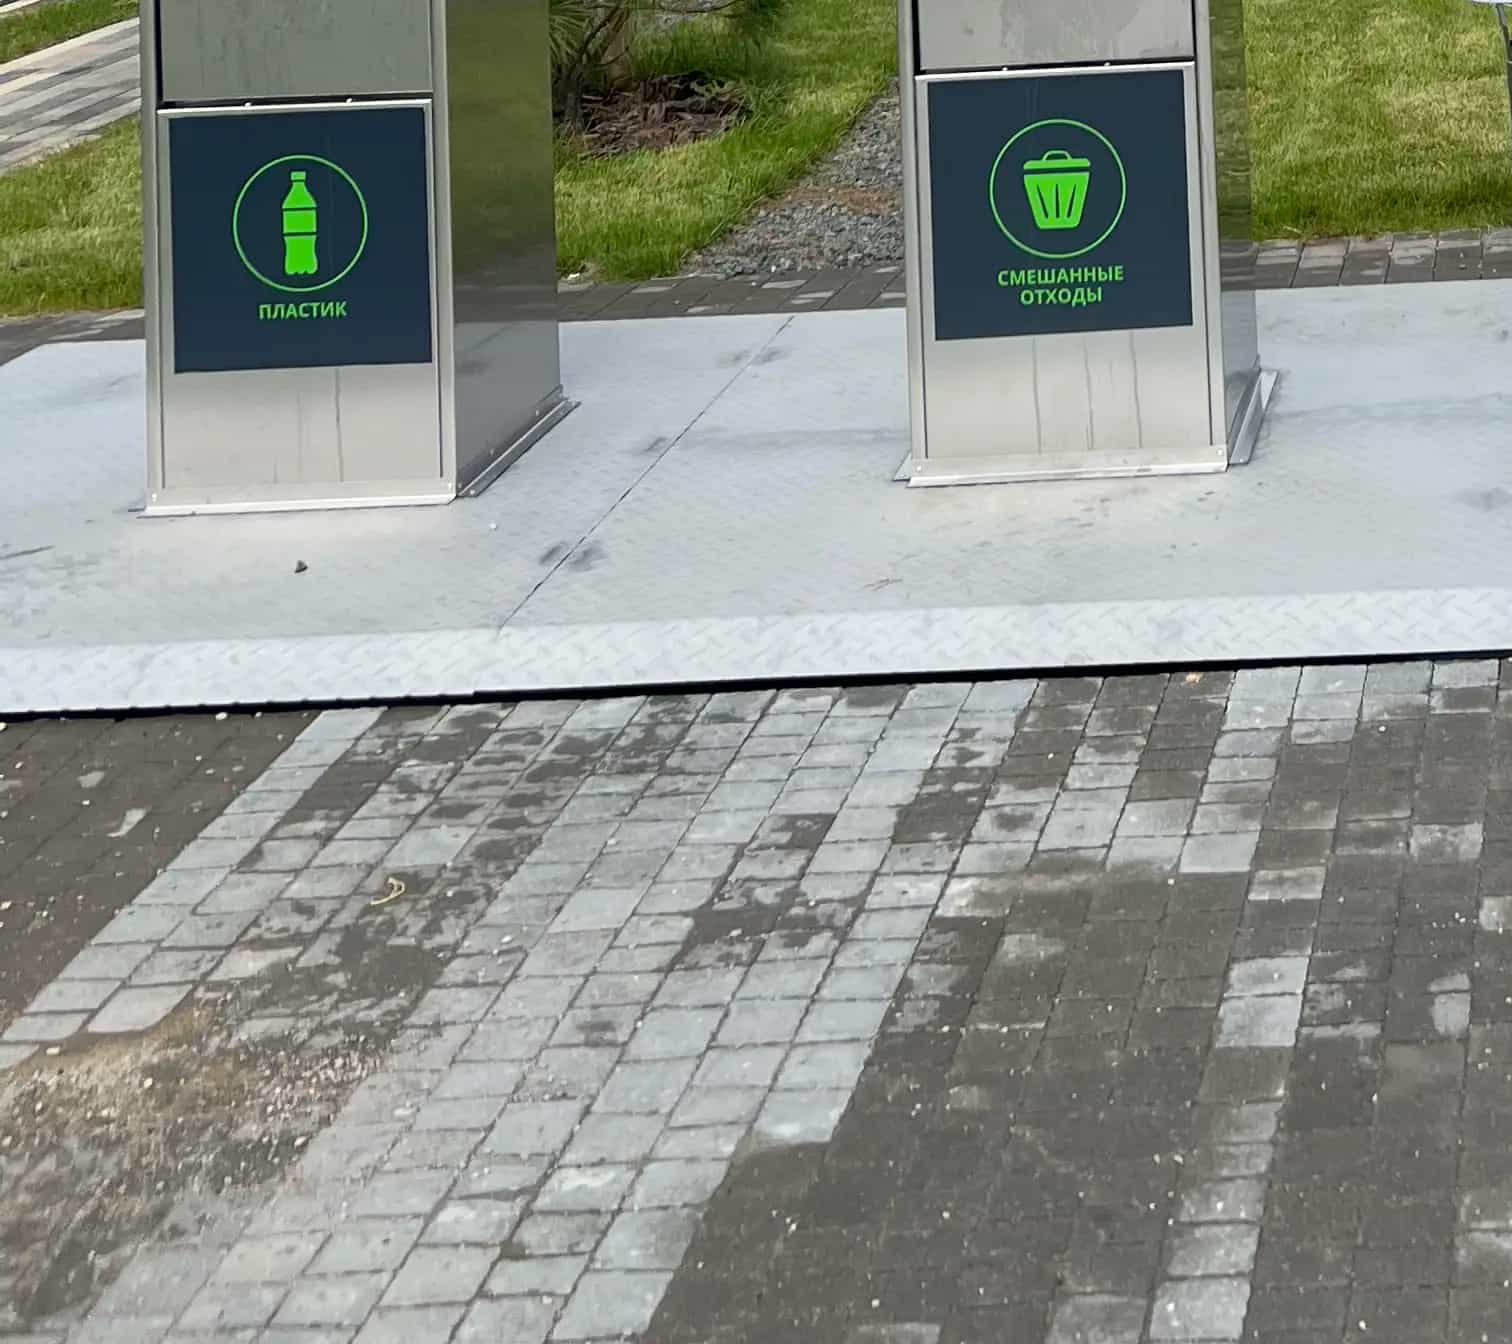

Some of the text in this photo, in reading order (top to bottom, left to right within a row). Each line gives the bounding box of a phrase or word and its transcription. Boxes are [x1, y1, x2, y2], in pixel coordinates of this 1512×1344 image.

[997, 265, 1124, 287] СМЕШАННЫЕ
[1020, 286, 1102, 307] ОТХОДЫ
[258, 301, 347, 320] ПЛАСТИК
